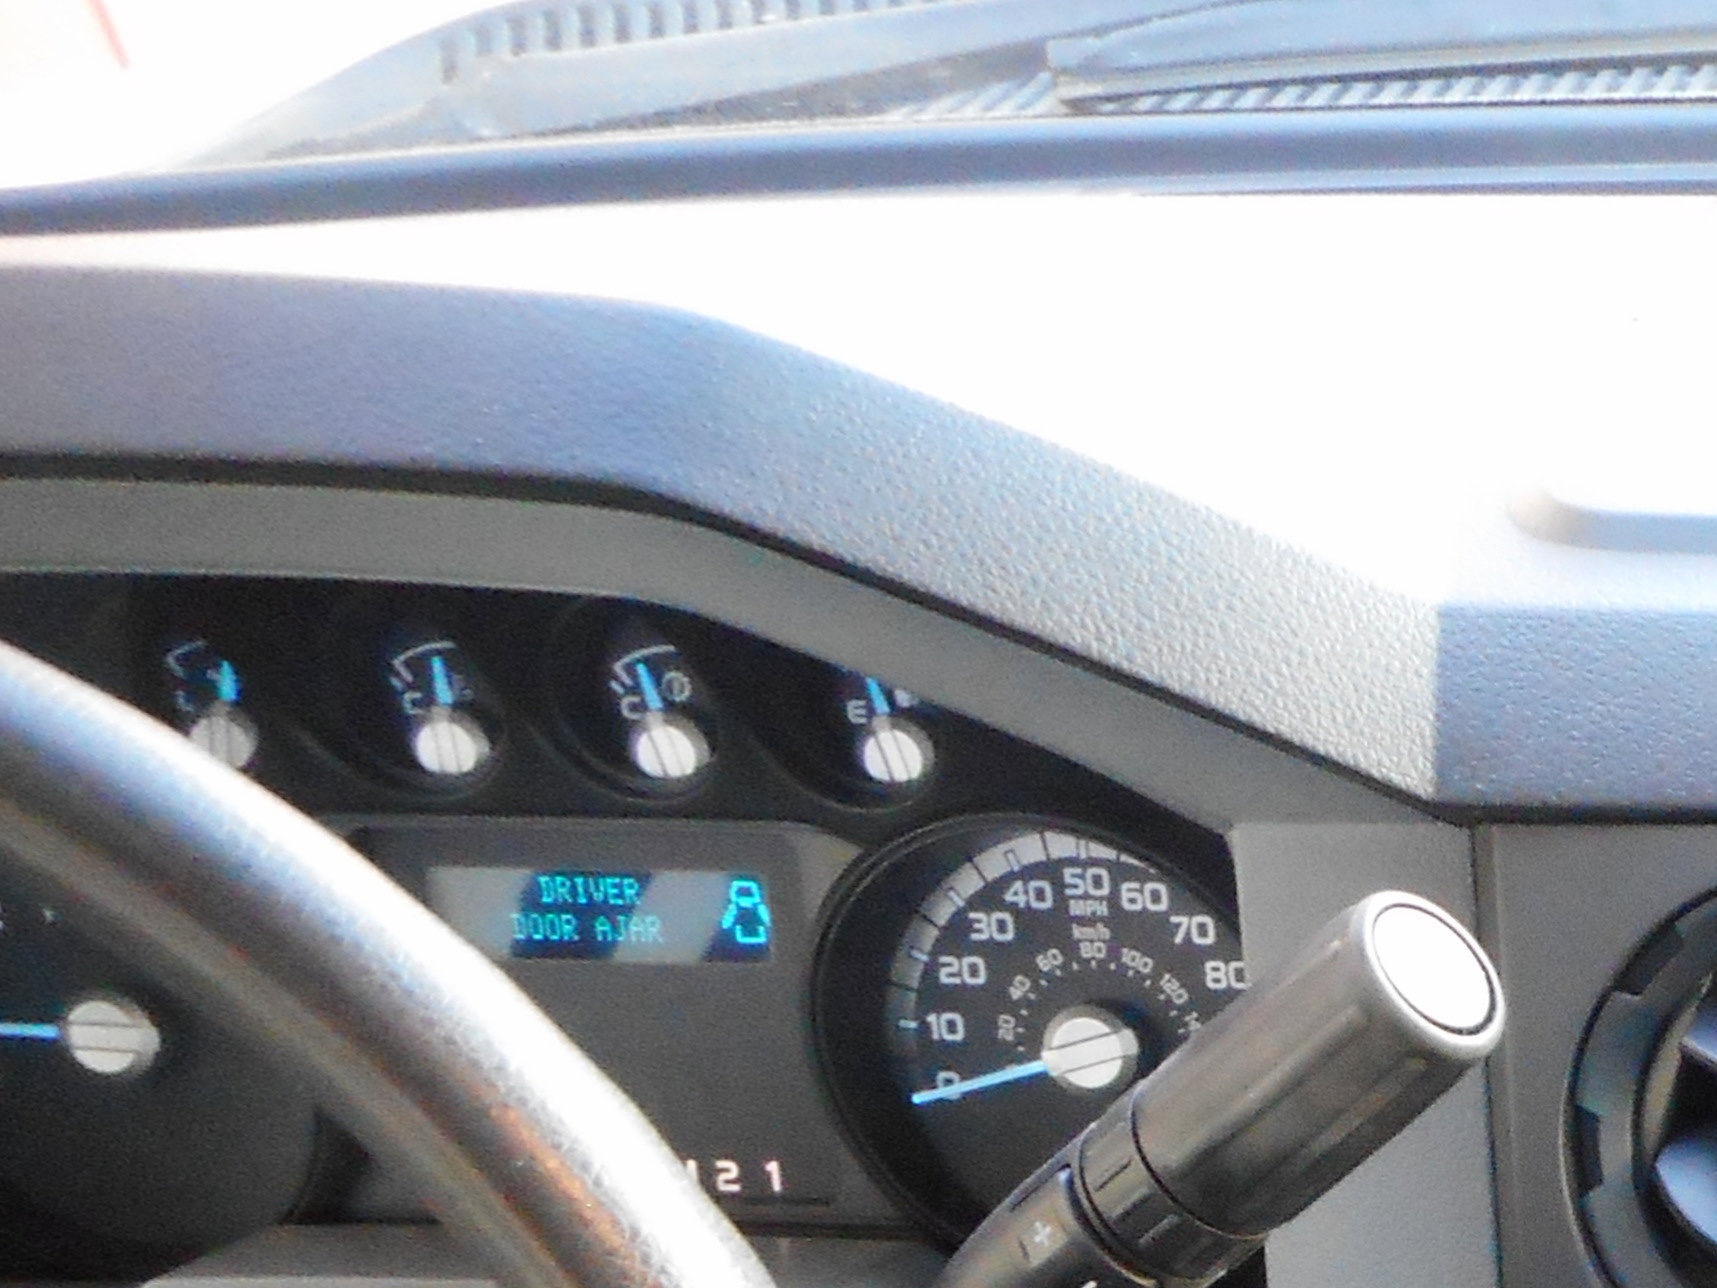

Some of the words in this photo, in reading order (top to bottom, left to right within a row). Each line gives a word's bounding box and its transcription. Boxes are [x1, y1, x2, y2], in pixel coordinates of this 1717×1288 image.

[846, 699, 868, 724] E
[537, 876, 641, 905] DRIVER
[1004, 879, 1054, 910] 40
[1063, 867, 1111, 897] 50
[1120, 881, 1169, 912] 60
[1069, 899, 1108, 917] MPH
[510, 913, 580, 941] DOOR
[594, 915, 663, 943] AJAR
[968, 911, 1016, 942] 30
[1169, 914, 1217, 946] 70
[1035, 948, 1064, 973] 60
[1079, 941, 1107, 959] 80
[1121, 947, 1154, 974] 100
[938, 955, 987, 985] 20
[1204, 960, 1248, 990] 80
[1009, 975, 1031, 1001] 40
[1160, 973, 1189, 1005] 120
[926, 1012, 965, 1041] 10
[998, 1014, 1016, 1041] 20
